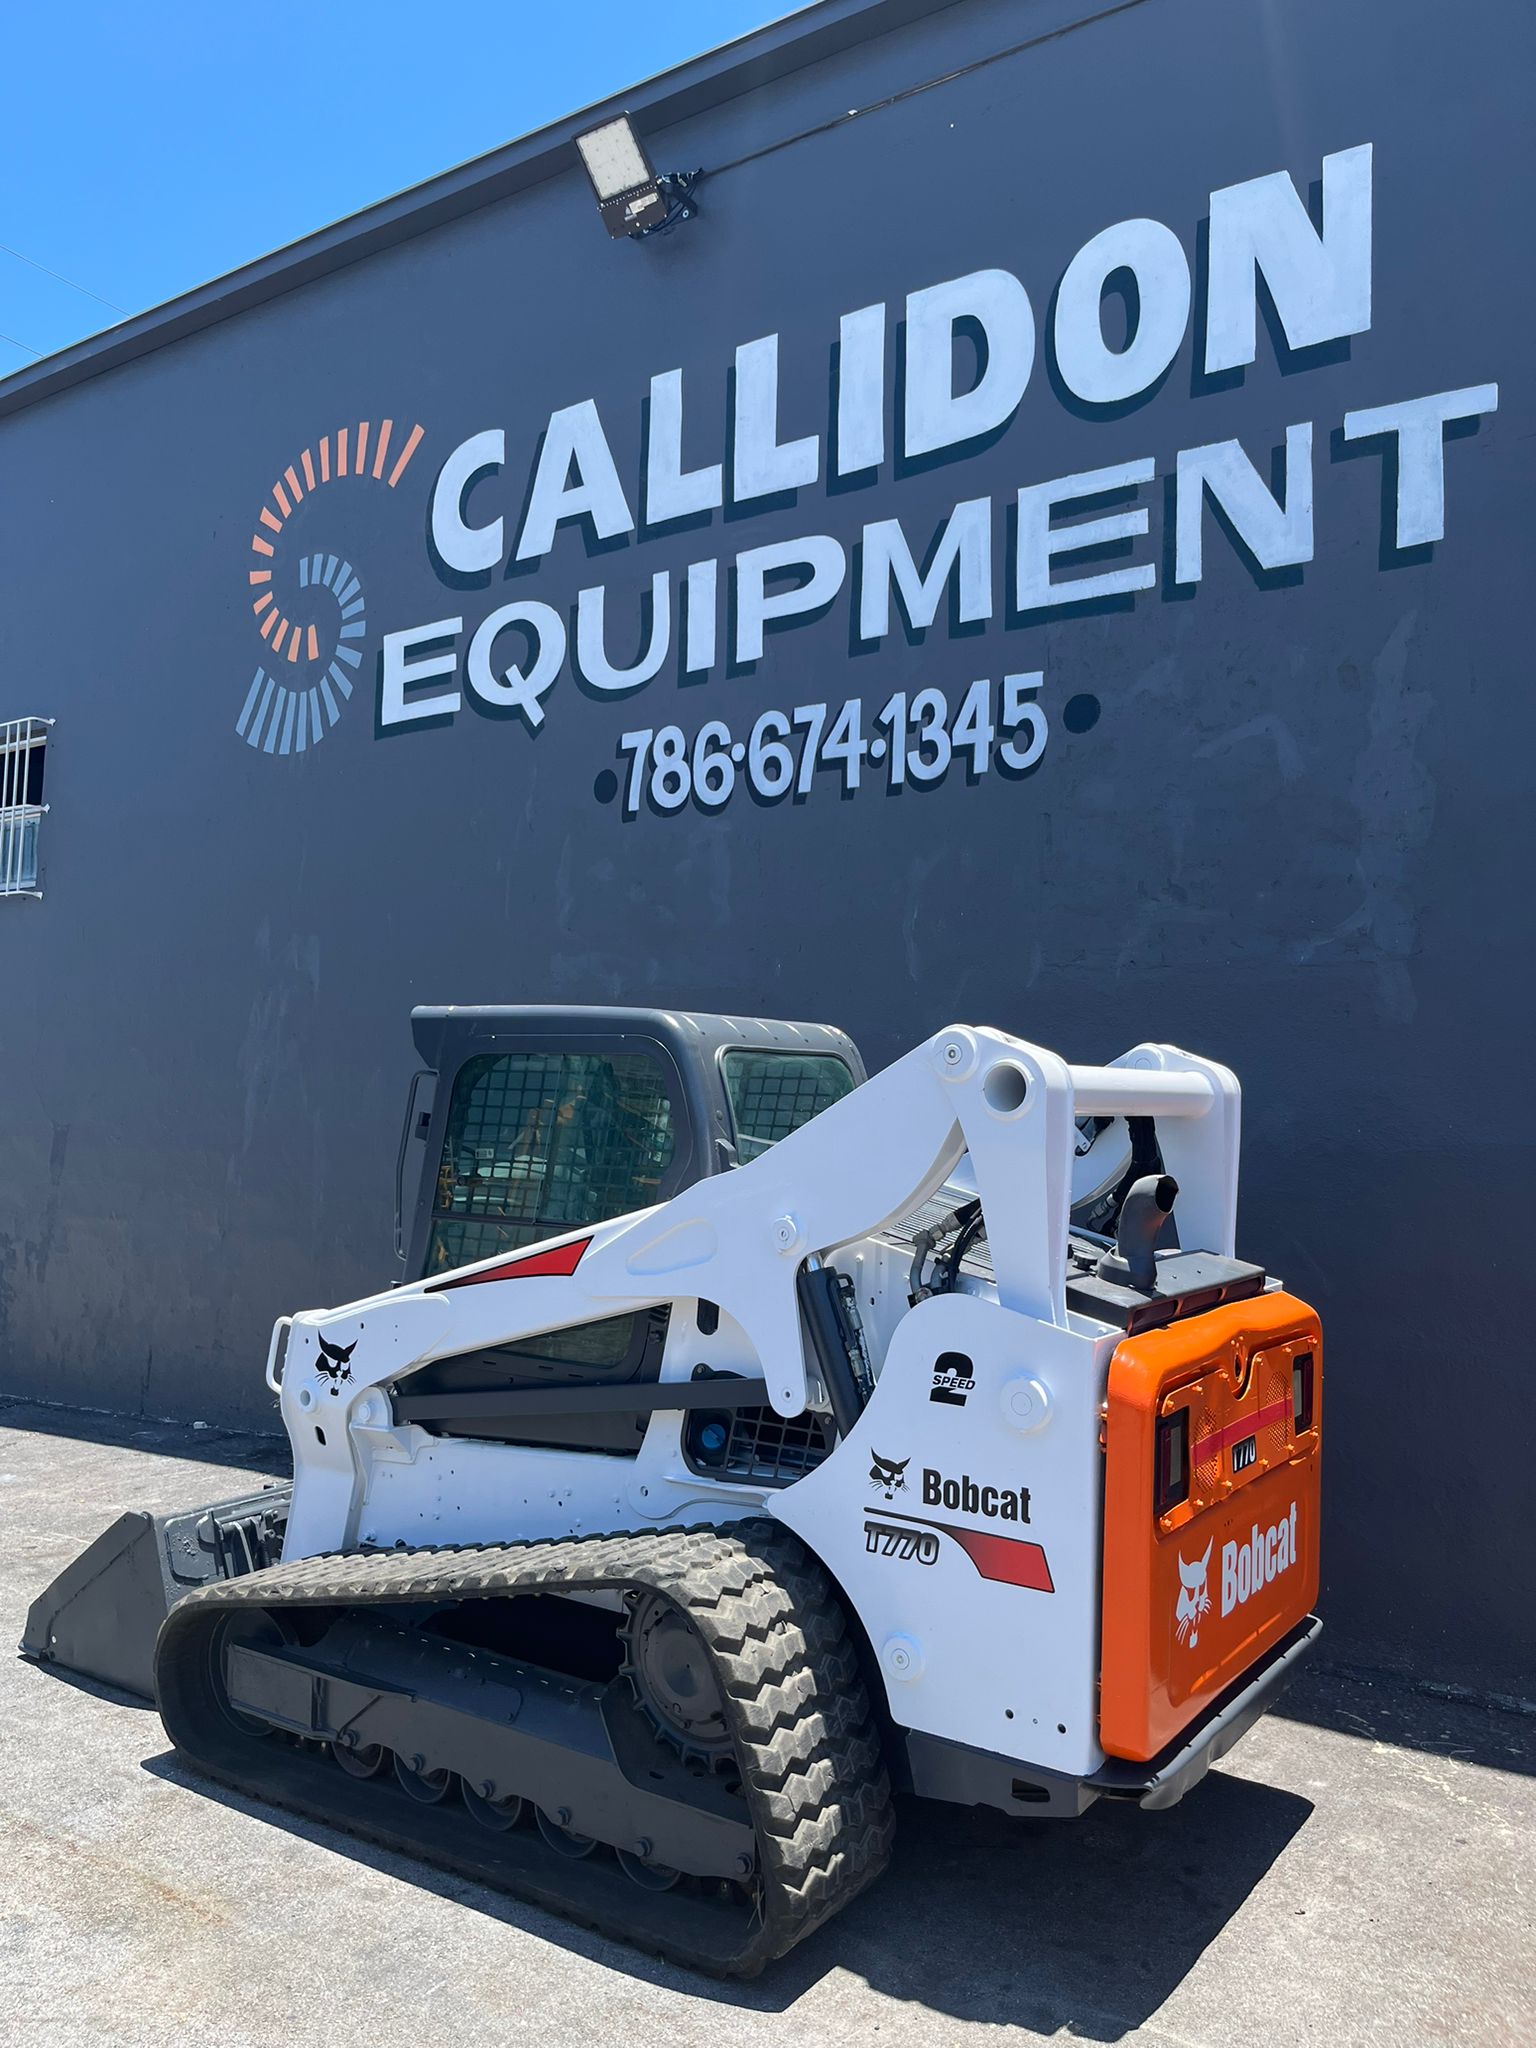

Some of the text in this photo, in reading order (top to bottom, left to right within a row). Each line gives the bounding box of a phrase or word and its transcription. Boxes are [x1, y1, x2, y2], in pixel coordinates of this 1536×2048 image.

[431, 142, 1373, 573] CALLIDON
[381, 382, 1499, 727] EQUIPMENT
[929, 1351, 974, 1407] 2
[932, 1374, 976, 1391] SPEED
[1233, 1439, 1256, 1471] T770
[922, 1468, 1031, 1524] Bobcat
[864, 1521, 940, 1566] T770
[1221, 1501, 1297, 1618] Bobcat
